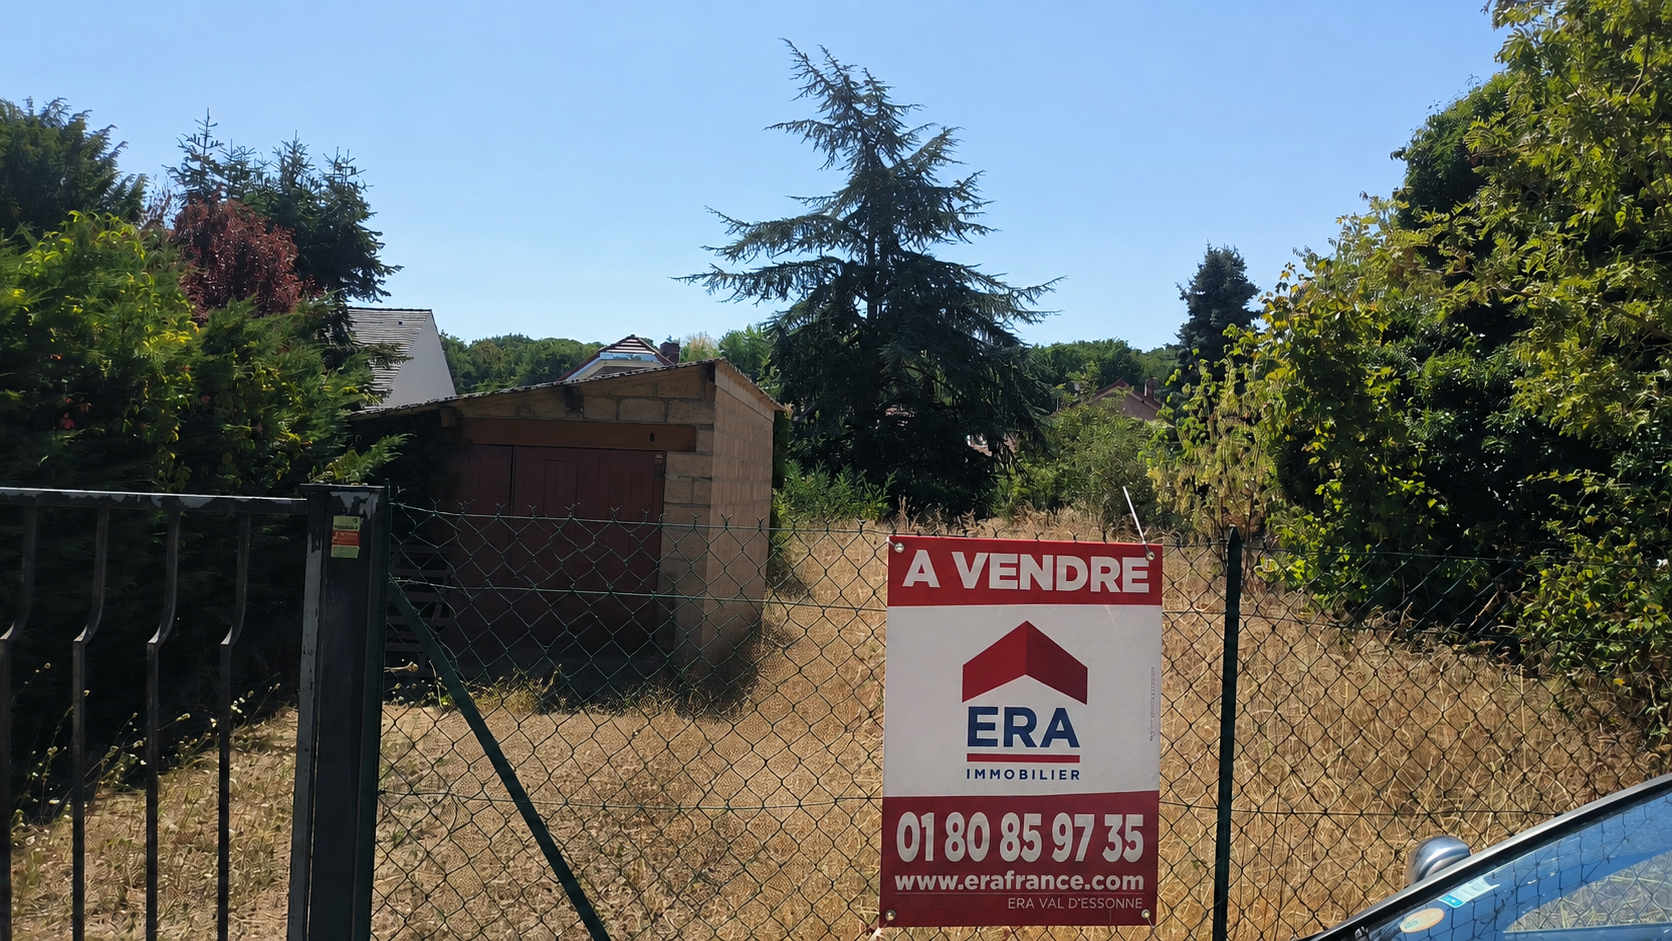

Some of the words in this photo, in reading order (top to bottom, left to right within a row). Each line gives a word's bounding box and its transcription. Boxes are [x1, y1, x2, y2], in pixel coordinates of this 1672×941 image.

[902, 550, 939, 588] A
[951, 551, 1150, 593] VENDRE
[967, 706, 1080, 748] ERA
[966, 768, 1080, 781] IMMOBILIER
[896, 811, 934, 862] 01
[944, 811, 990, 862] 80
[999, 812, 1042, 862] 85
[1051, 812, 1095, 862] 97
[1102, 813, 1144, 862] 35
[895, 870, 1144, 891] www.erafrance.com
[1008, 898, 1034, 909] ERA
[1038, 898, 1066, 909] VAL
[1069, 897, 1143, 909] D'ESSONNE
